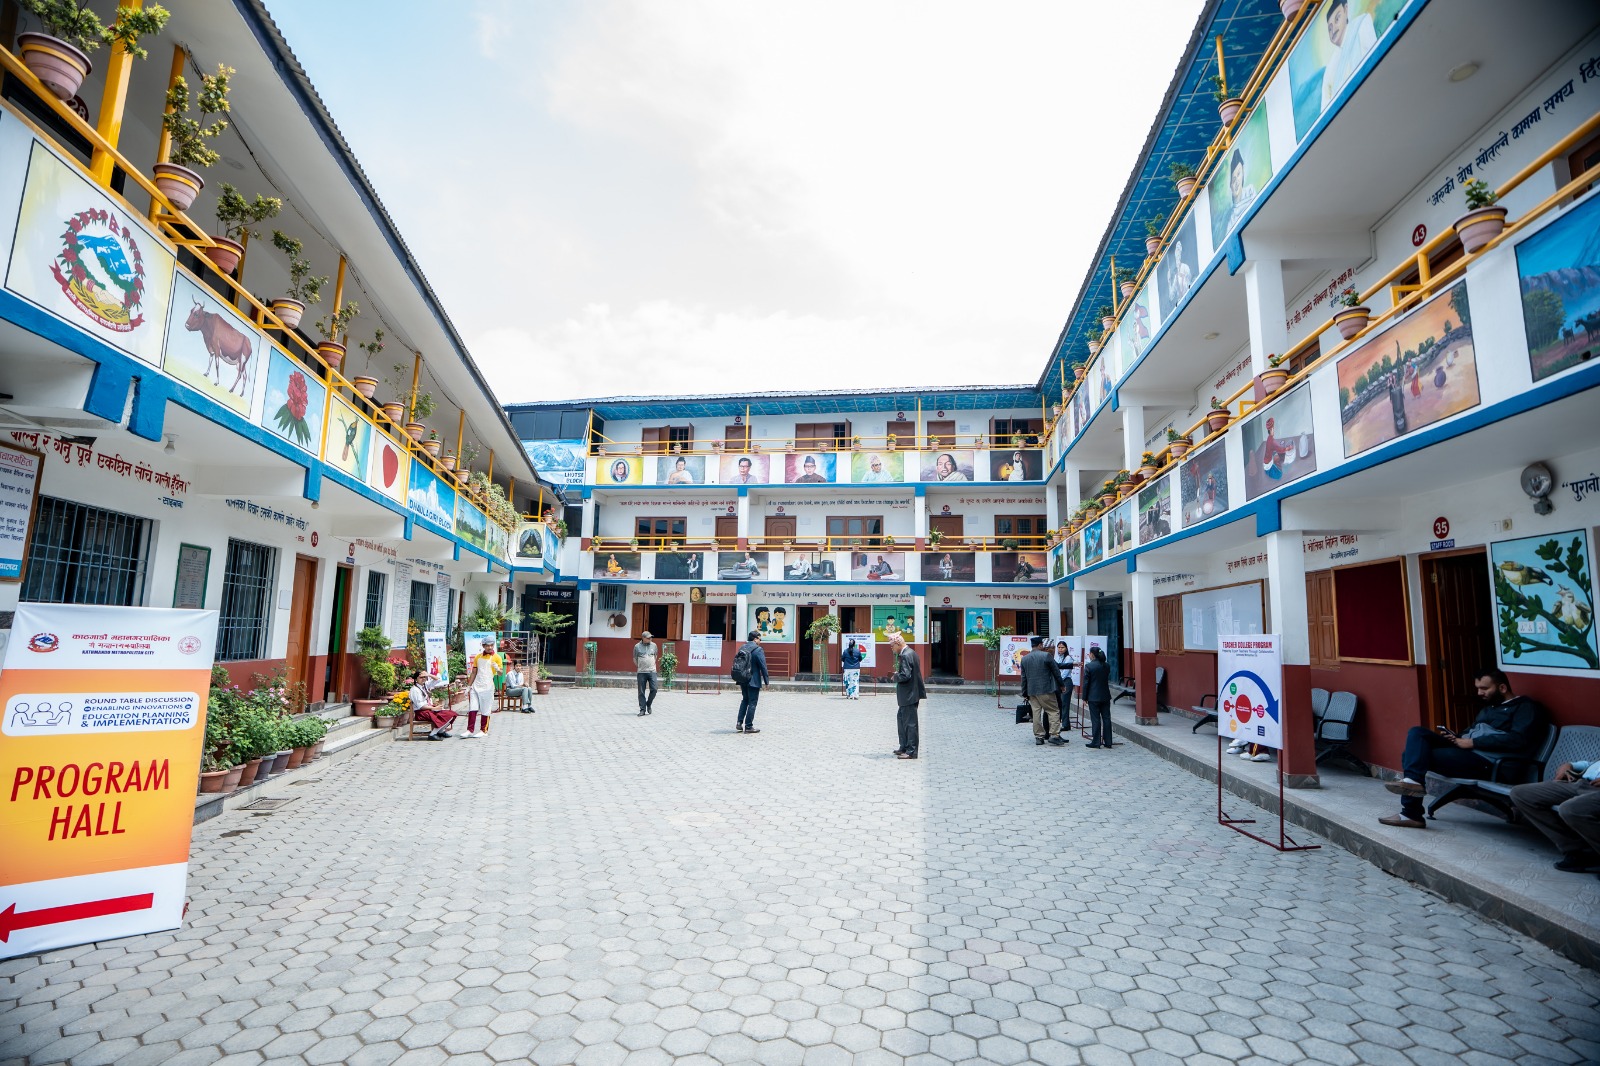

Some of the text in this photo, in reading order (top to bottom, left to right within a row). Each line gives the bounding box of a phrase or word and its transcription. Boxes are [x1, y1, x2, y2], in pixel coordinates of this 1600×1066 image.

[1512, 106, 1542, 140] काममा
[1543, 80, 1575, 114] समय
[1414, 227, 1424, 242] 43
[98, 453, 132, 476] एकछिन
[1436, 522, 1448, 534] 35
[539, 589, 558, 597] चमेना
[93, 718, 190, 726] IMPLEMENTATION
[10, 759, 169, 802] PROGRAM
[48, 801, 125, 841] HALL
